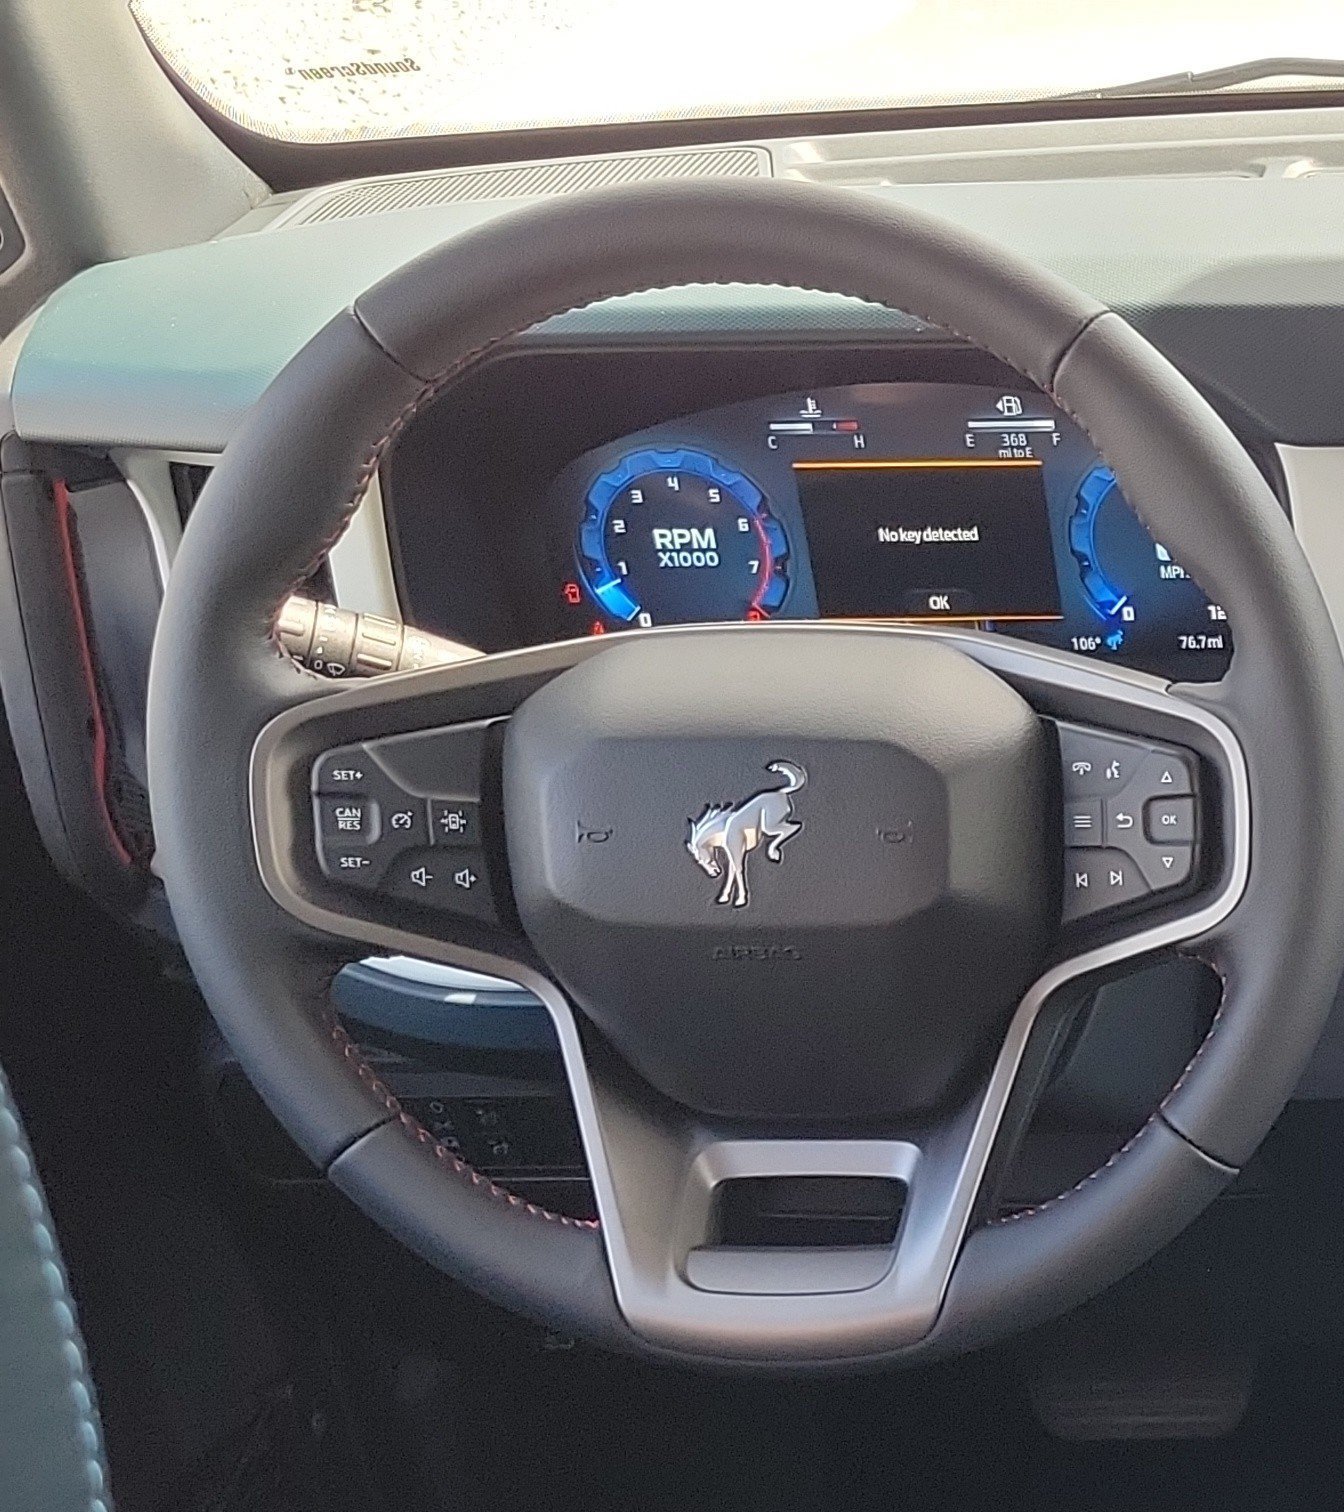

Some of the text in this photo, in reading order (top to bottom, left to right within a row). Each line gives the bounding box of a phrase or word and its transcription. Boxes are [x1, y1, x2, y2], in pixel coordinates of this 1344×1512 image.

[768, 436, 778, 450] C
[853, 434, 865, 449] H
[965, 434, 976, 448] E
[1000, 433, 1027, 447] 368
[1052, 432, 1062, 446] F
[667, 477, 680, 491] 4
[630, 490, 644, 504] 3
[708, 489, 721, 503] 5
[612, 520, 626, 534] 2
[737, 518, 750, 532] 6
[652, 528, 717, 550] RPM
[877, 526, 980, 544] No key detected
[659, 552, 720, 568] X1000
[617, 562, 629, 576] 1
[748, 561, 761, 575] 7
[929, 595, 950, 610] OK
[335, 807, 362, 819] CAN
[1161, 815, 1177, 825] OK
[337, 820, 361, 831] RES
